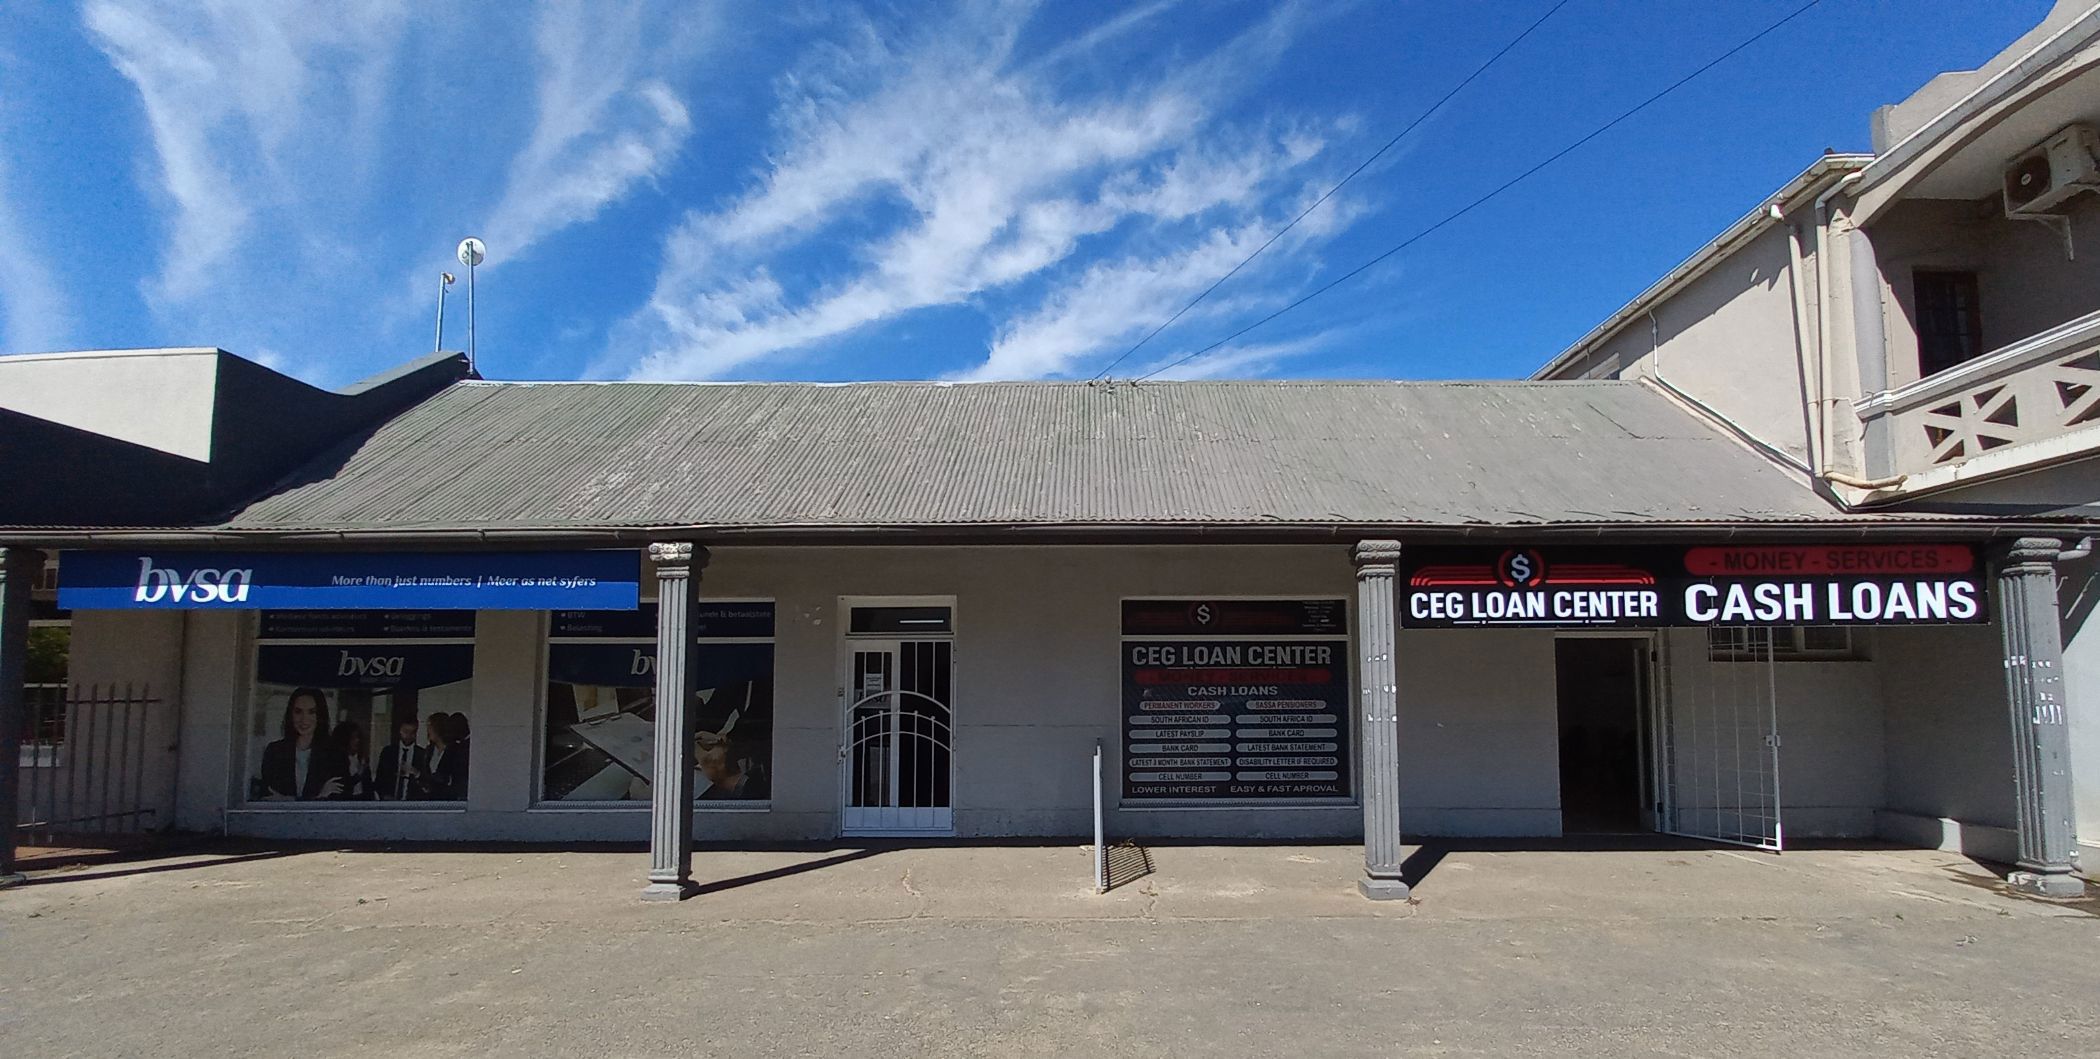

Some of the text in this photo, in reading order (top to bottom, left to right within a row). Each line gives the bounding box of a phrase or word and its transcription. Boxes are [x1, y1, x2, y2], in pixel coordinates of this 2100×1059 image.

[1724, 552, 1806, 570] MONEY
[1826, 551, 1938, 569] SERVICES
[135, 556, 254, 603] bvsa
[332, 575, 363, 586] More
[365, 575, 392, 586] than
[393, 575, 417, 588] just
[419, 575, 472, 586] numbers
[487, 575, 519, 586] Meer
[522, 577, 535, 586] as
[538, 575, 556, 586] net
[559, 575, 597, 588] syfers
[1410, 590, 1658, 619] CEG LOAN CENTER
[1684, 581, 1977, 622] CASH LOANS
[337, 650, 405, 676] bvsa
[1132, 645, 1332, 666] CEG LOAN CENTER
[1187, 686, 1278, 696] CASH LOANS
[1169, 785, 1217, 793] INTEREST
[1230, 785, 1256, 793] EASY
[1293, 784, 1339, 792] APROVAL
